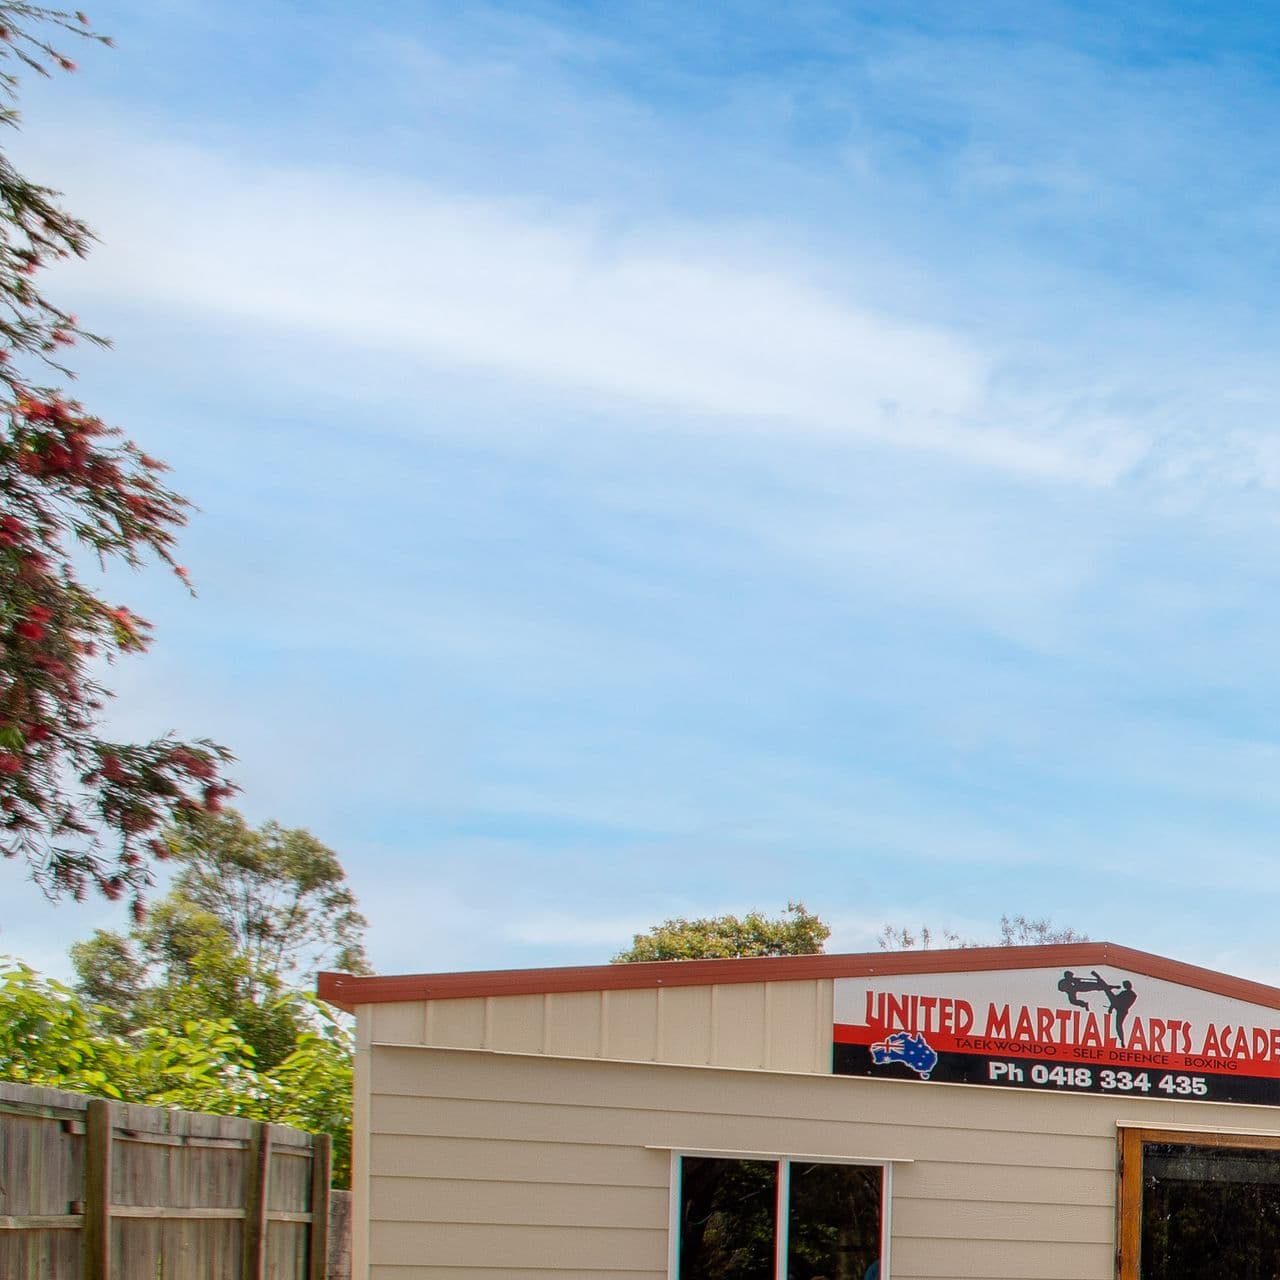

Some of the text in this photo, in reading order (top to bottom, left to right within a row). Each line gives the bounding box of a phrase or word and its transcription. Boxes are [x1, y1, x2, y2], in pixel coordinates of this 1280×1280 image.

[865, 990, 975, 1036] UNITED
[984, 1002, 1118, 1049] MARTIAL
[1127, 1016, 1192, 1054] ARTS
[1073, 1047, 1104, 1060] SELF
[1109, 1051, 1169, 1065] DEFENCE
[1184, 1057, 1238, 1071] BOXING
[988, 1061, 1208, 1096] Ph 0418 334 435
